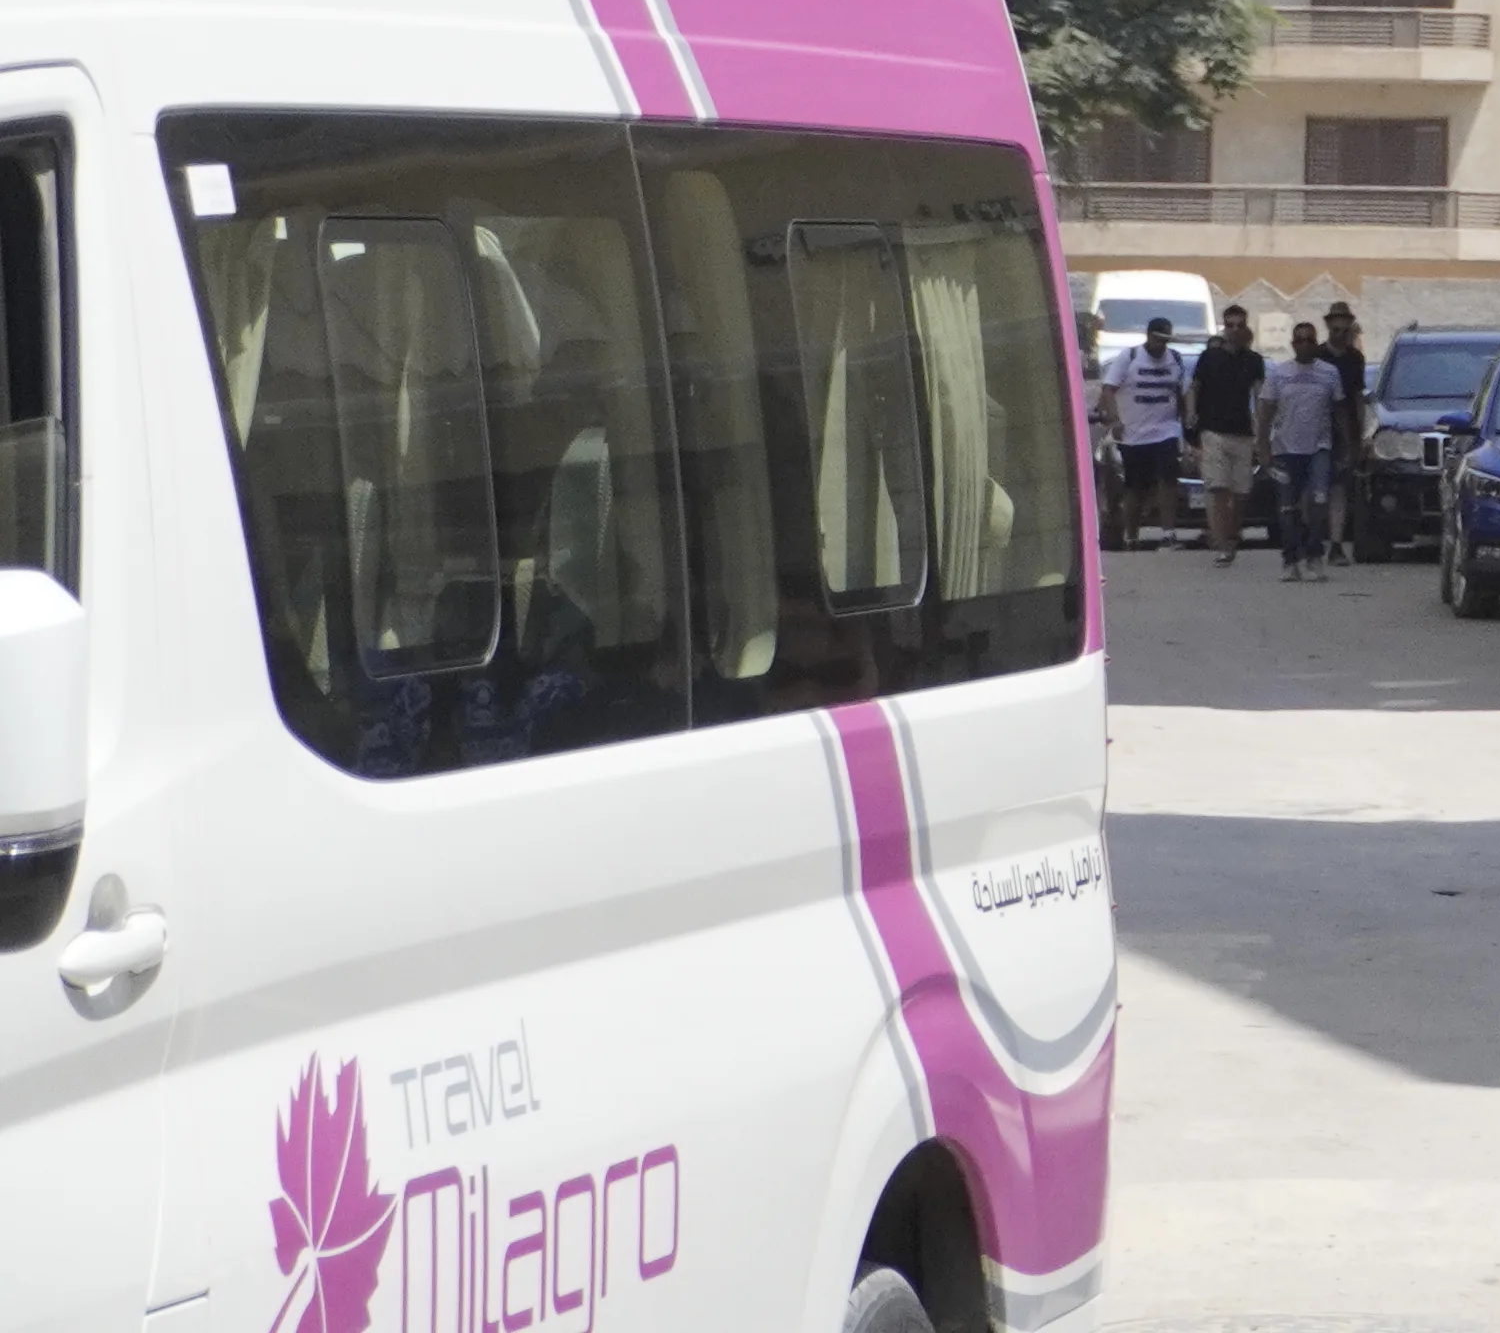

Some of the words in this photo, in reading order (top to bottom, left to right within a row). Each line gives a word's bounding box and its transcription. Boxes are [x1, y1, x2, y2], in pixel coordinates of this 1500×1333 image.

[972, 864, 1023, 917] للسياحة
[1066, 845, 1101, 900] ترافيل
[390, 1017, 541, 1149] Travel
